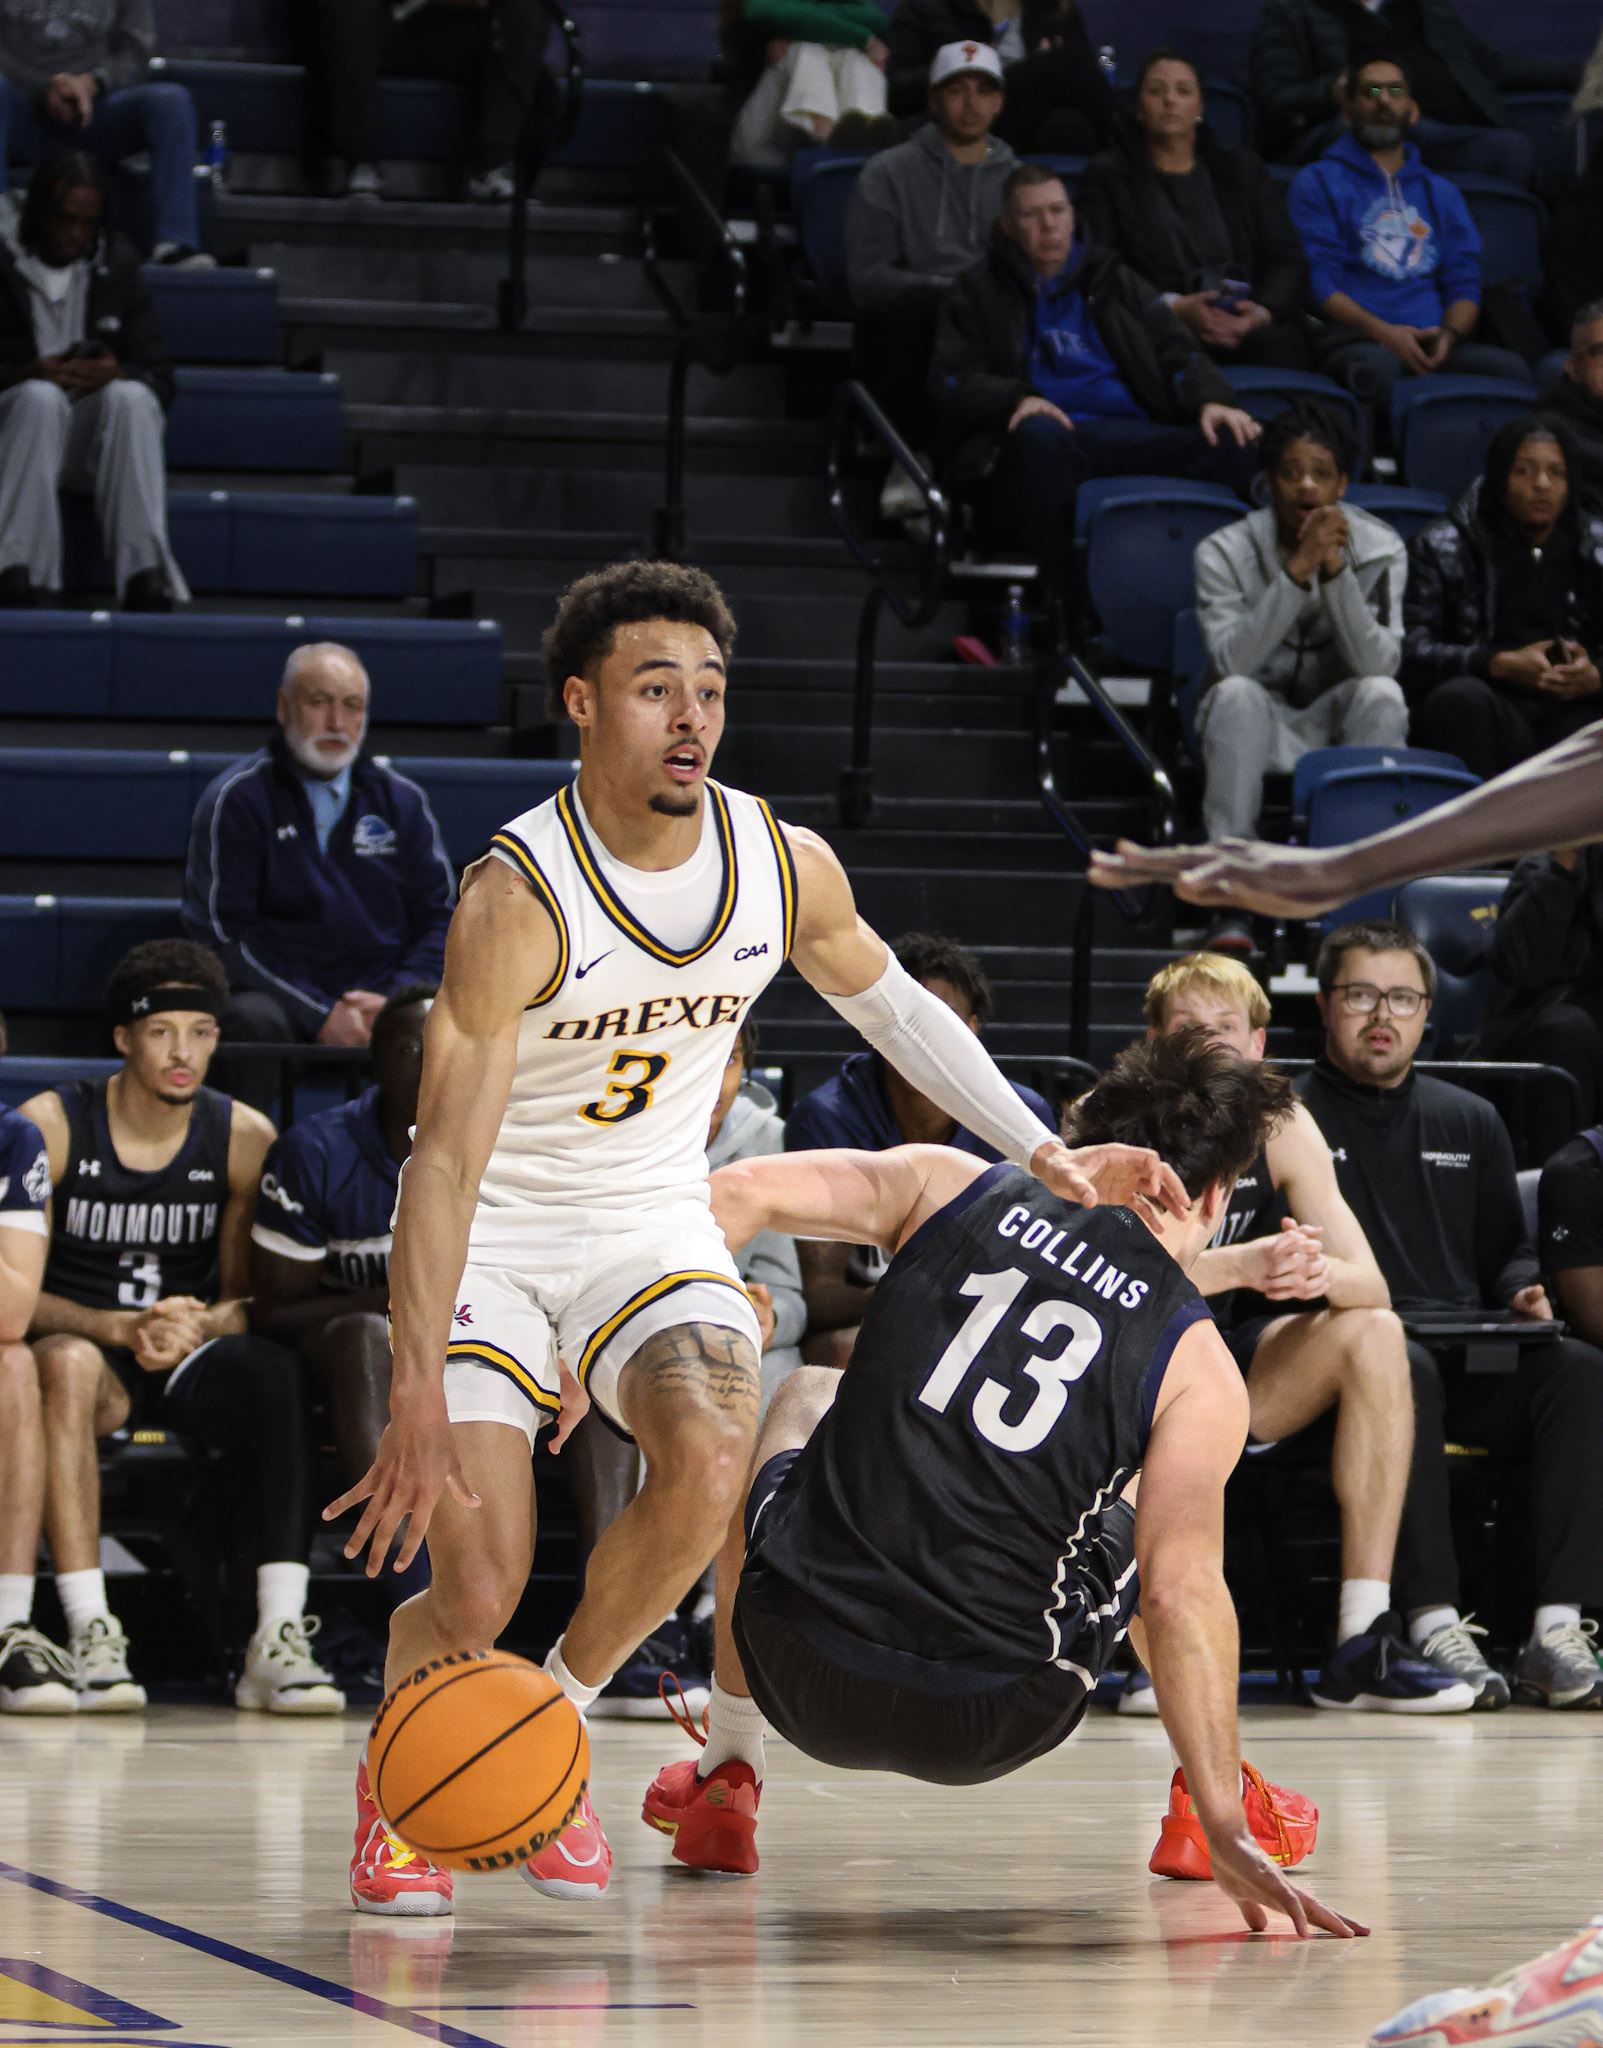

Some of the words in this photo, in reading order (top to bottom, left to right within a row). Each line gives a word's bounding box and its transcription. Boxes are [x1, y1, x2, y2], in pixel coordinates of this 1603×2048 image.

[733, 942, 768, 961] CAA
[577, 1048, 672, 1127] 3
[1235, 1177, 1258, 1189] CAA
[65, 1197, 218, 1245] MONMOUTH
[117, 1251, 163, 1309] 3
[997, 1205, 1150, 1310] COLLINS
[916, 1265, 1104, 1453] 13
